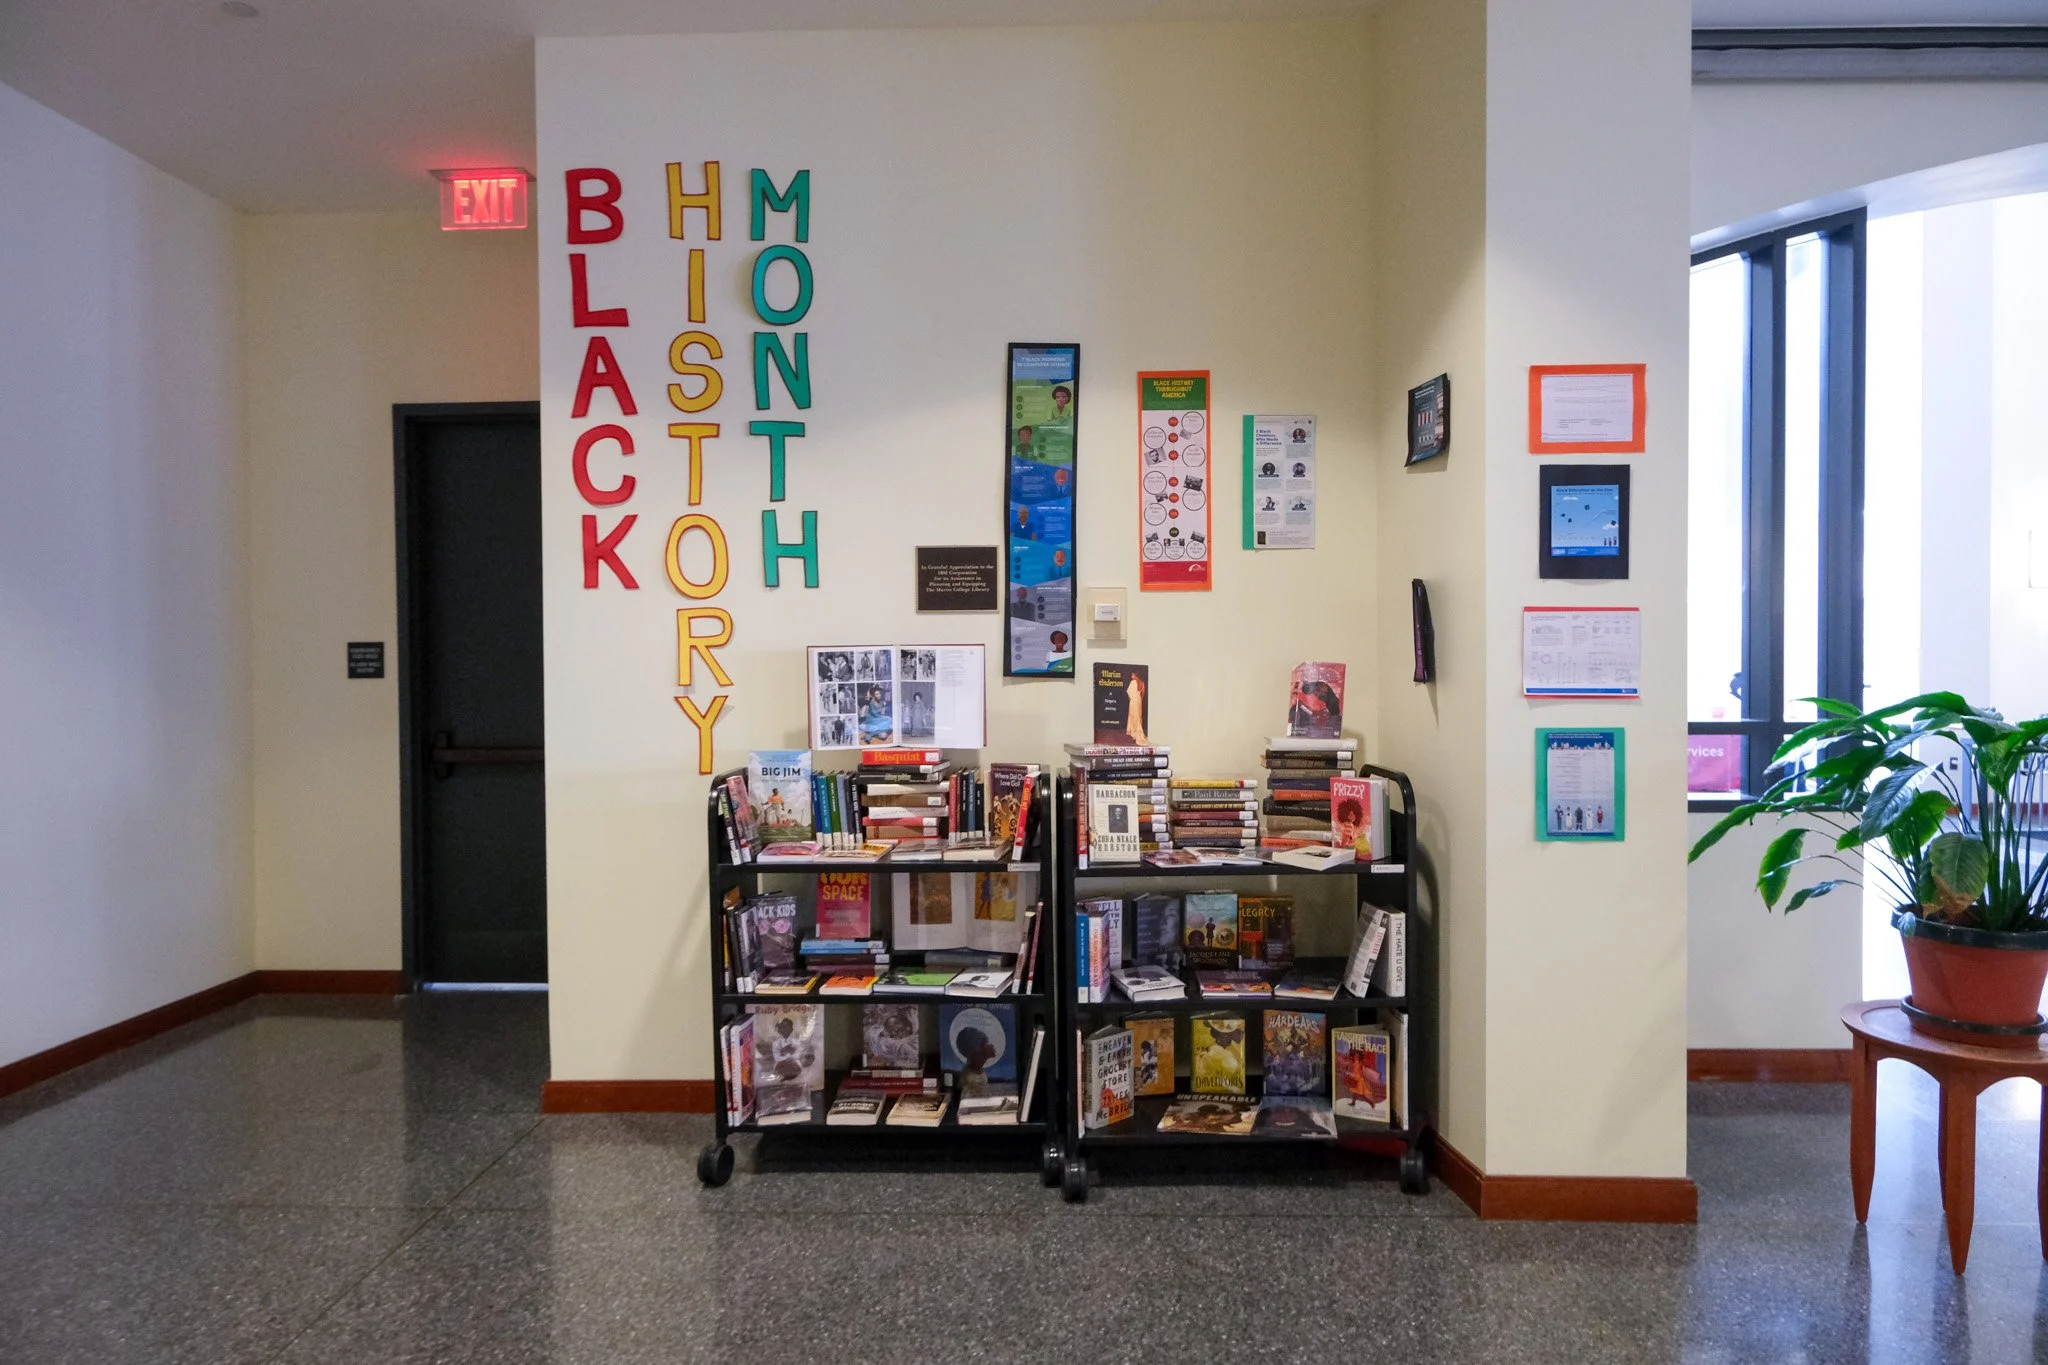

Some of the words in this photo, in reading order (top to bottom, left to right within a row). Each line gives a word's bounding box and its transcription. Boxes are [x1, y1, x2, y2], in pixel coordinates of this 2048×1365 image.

[454, 179, 517, 224] EXIT
[565, 168, 640, 590] BLACK
[750, 168, 819, 588] MONTH
[665, 161, 734, 774] HISTORY
[875, 751, 920, 764] Basquiat
[762, 768, 780, 776] BIG
[783, 768, 801, 777] JIM
[1194, 790, 1209, 798] Paul
[1214, 790, 1240, 798] Robes
[1098, 835, 1115, 843] ZORA
[1117, 835, 1137, 843] NEALE
[823, 885, 864, 900] SPACE
[758, 905, 775, 919] ACK
[777, 904, 796, 918] KIDS
[1242, 907, 1276, 917] LEGACY
[755, 1006, 778, 1016] Ruby
[1269, 1015, 1320, 1033] HARDEARS
[1103, 1035, 1132, 1053] HEAVEN
[1348, 1042, 1363, 1051] THE
[1365, 1043, 1386, 1053] RACE
[1107, 1047, 1131, 1062] EARTH
[1098, 1059, 1131, 1079] GROCERY
[1103, 1074, 1127, 1089] STORE
[1177, 1094, 1257, 1102] UNSPEAKABLE
